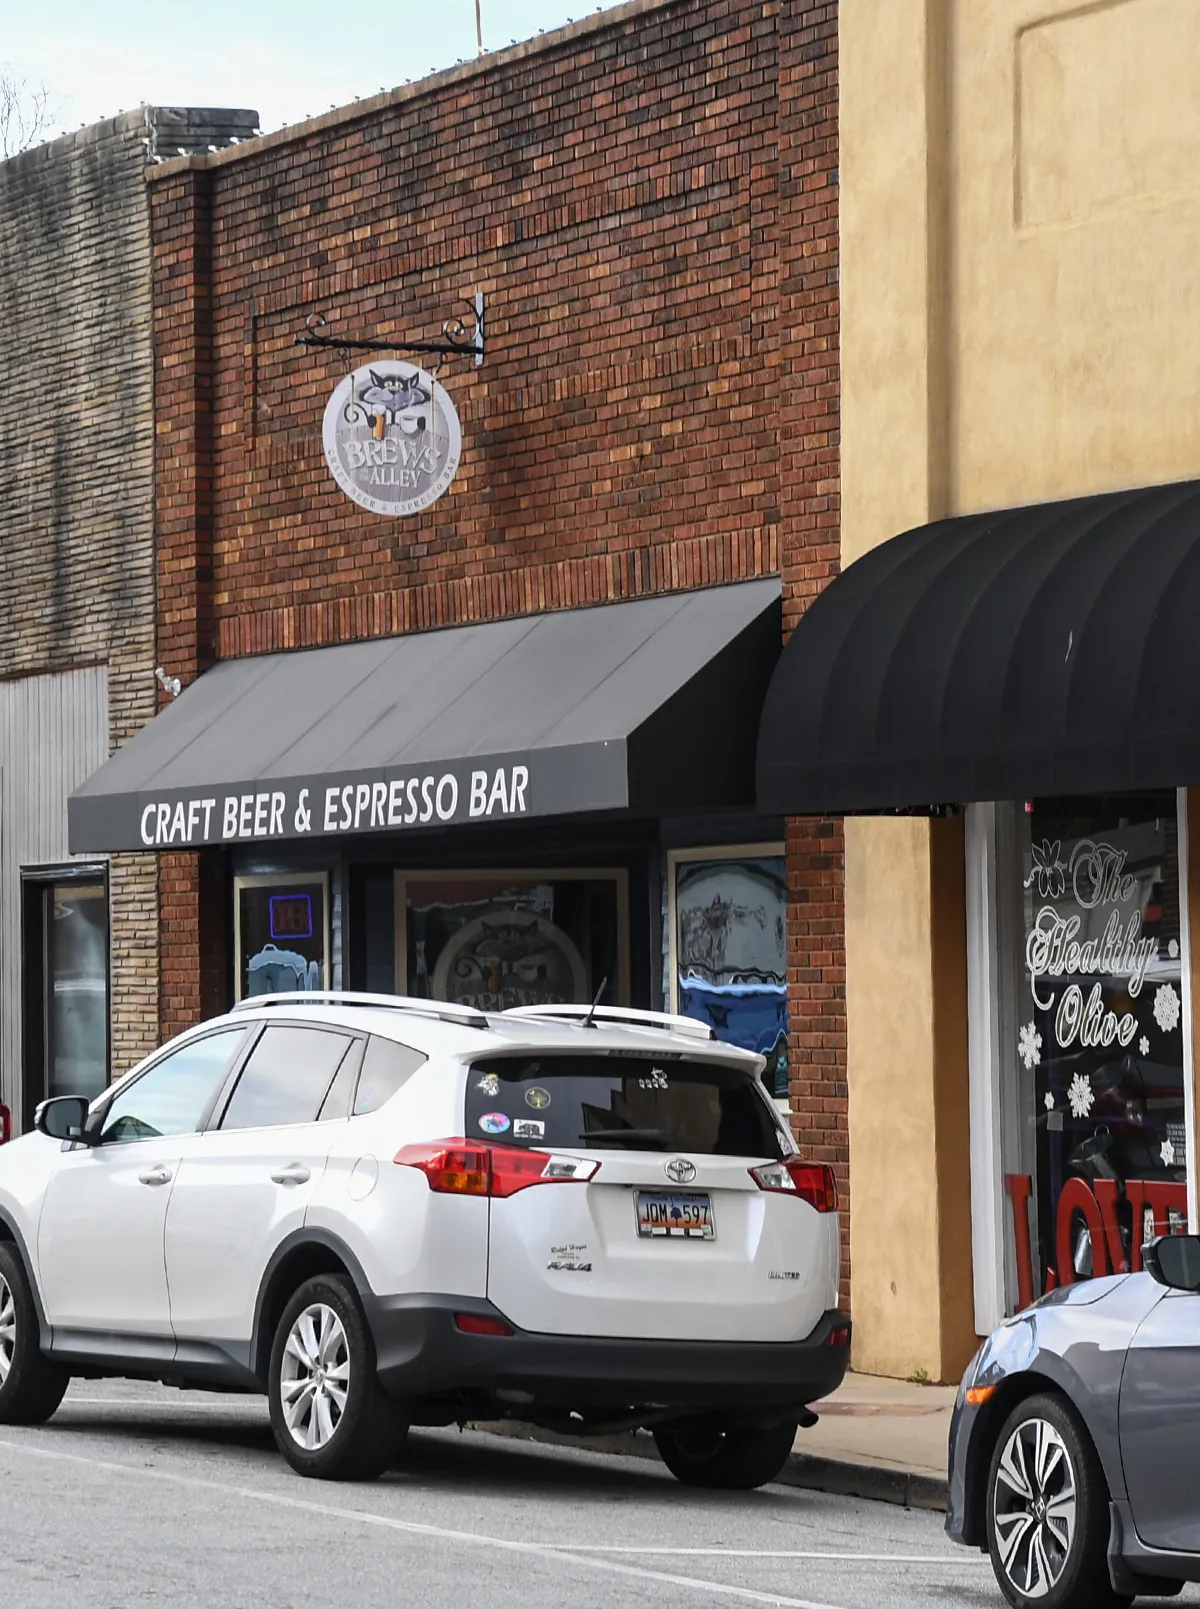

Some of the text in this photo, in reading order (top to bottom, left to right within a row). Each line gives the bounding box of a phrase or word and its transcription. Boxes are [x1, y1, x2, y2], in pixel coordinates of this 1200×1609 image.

[343, 436, 441, 475] BREWS
[369, 467, 421, 488] ALLEY
[442, 458, 456, 480] BAR
[140, 765, 529, 845] CRAFT BEER & ESPRESSO BAR
[1068, 838, 1138, 909] The
[1026, 905, 1158, 1011] Healthy
[1054, 982, 1140, 1048] Olive
[642, 1202, 708, 1224] JQM 597
